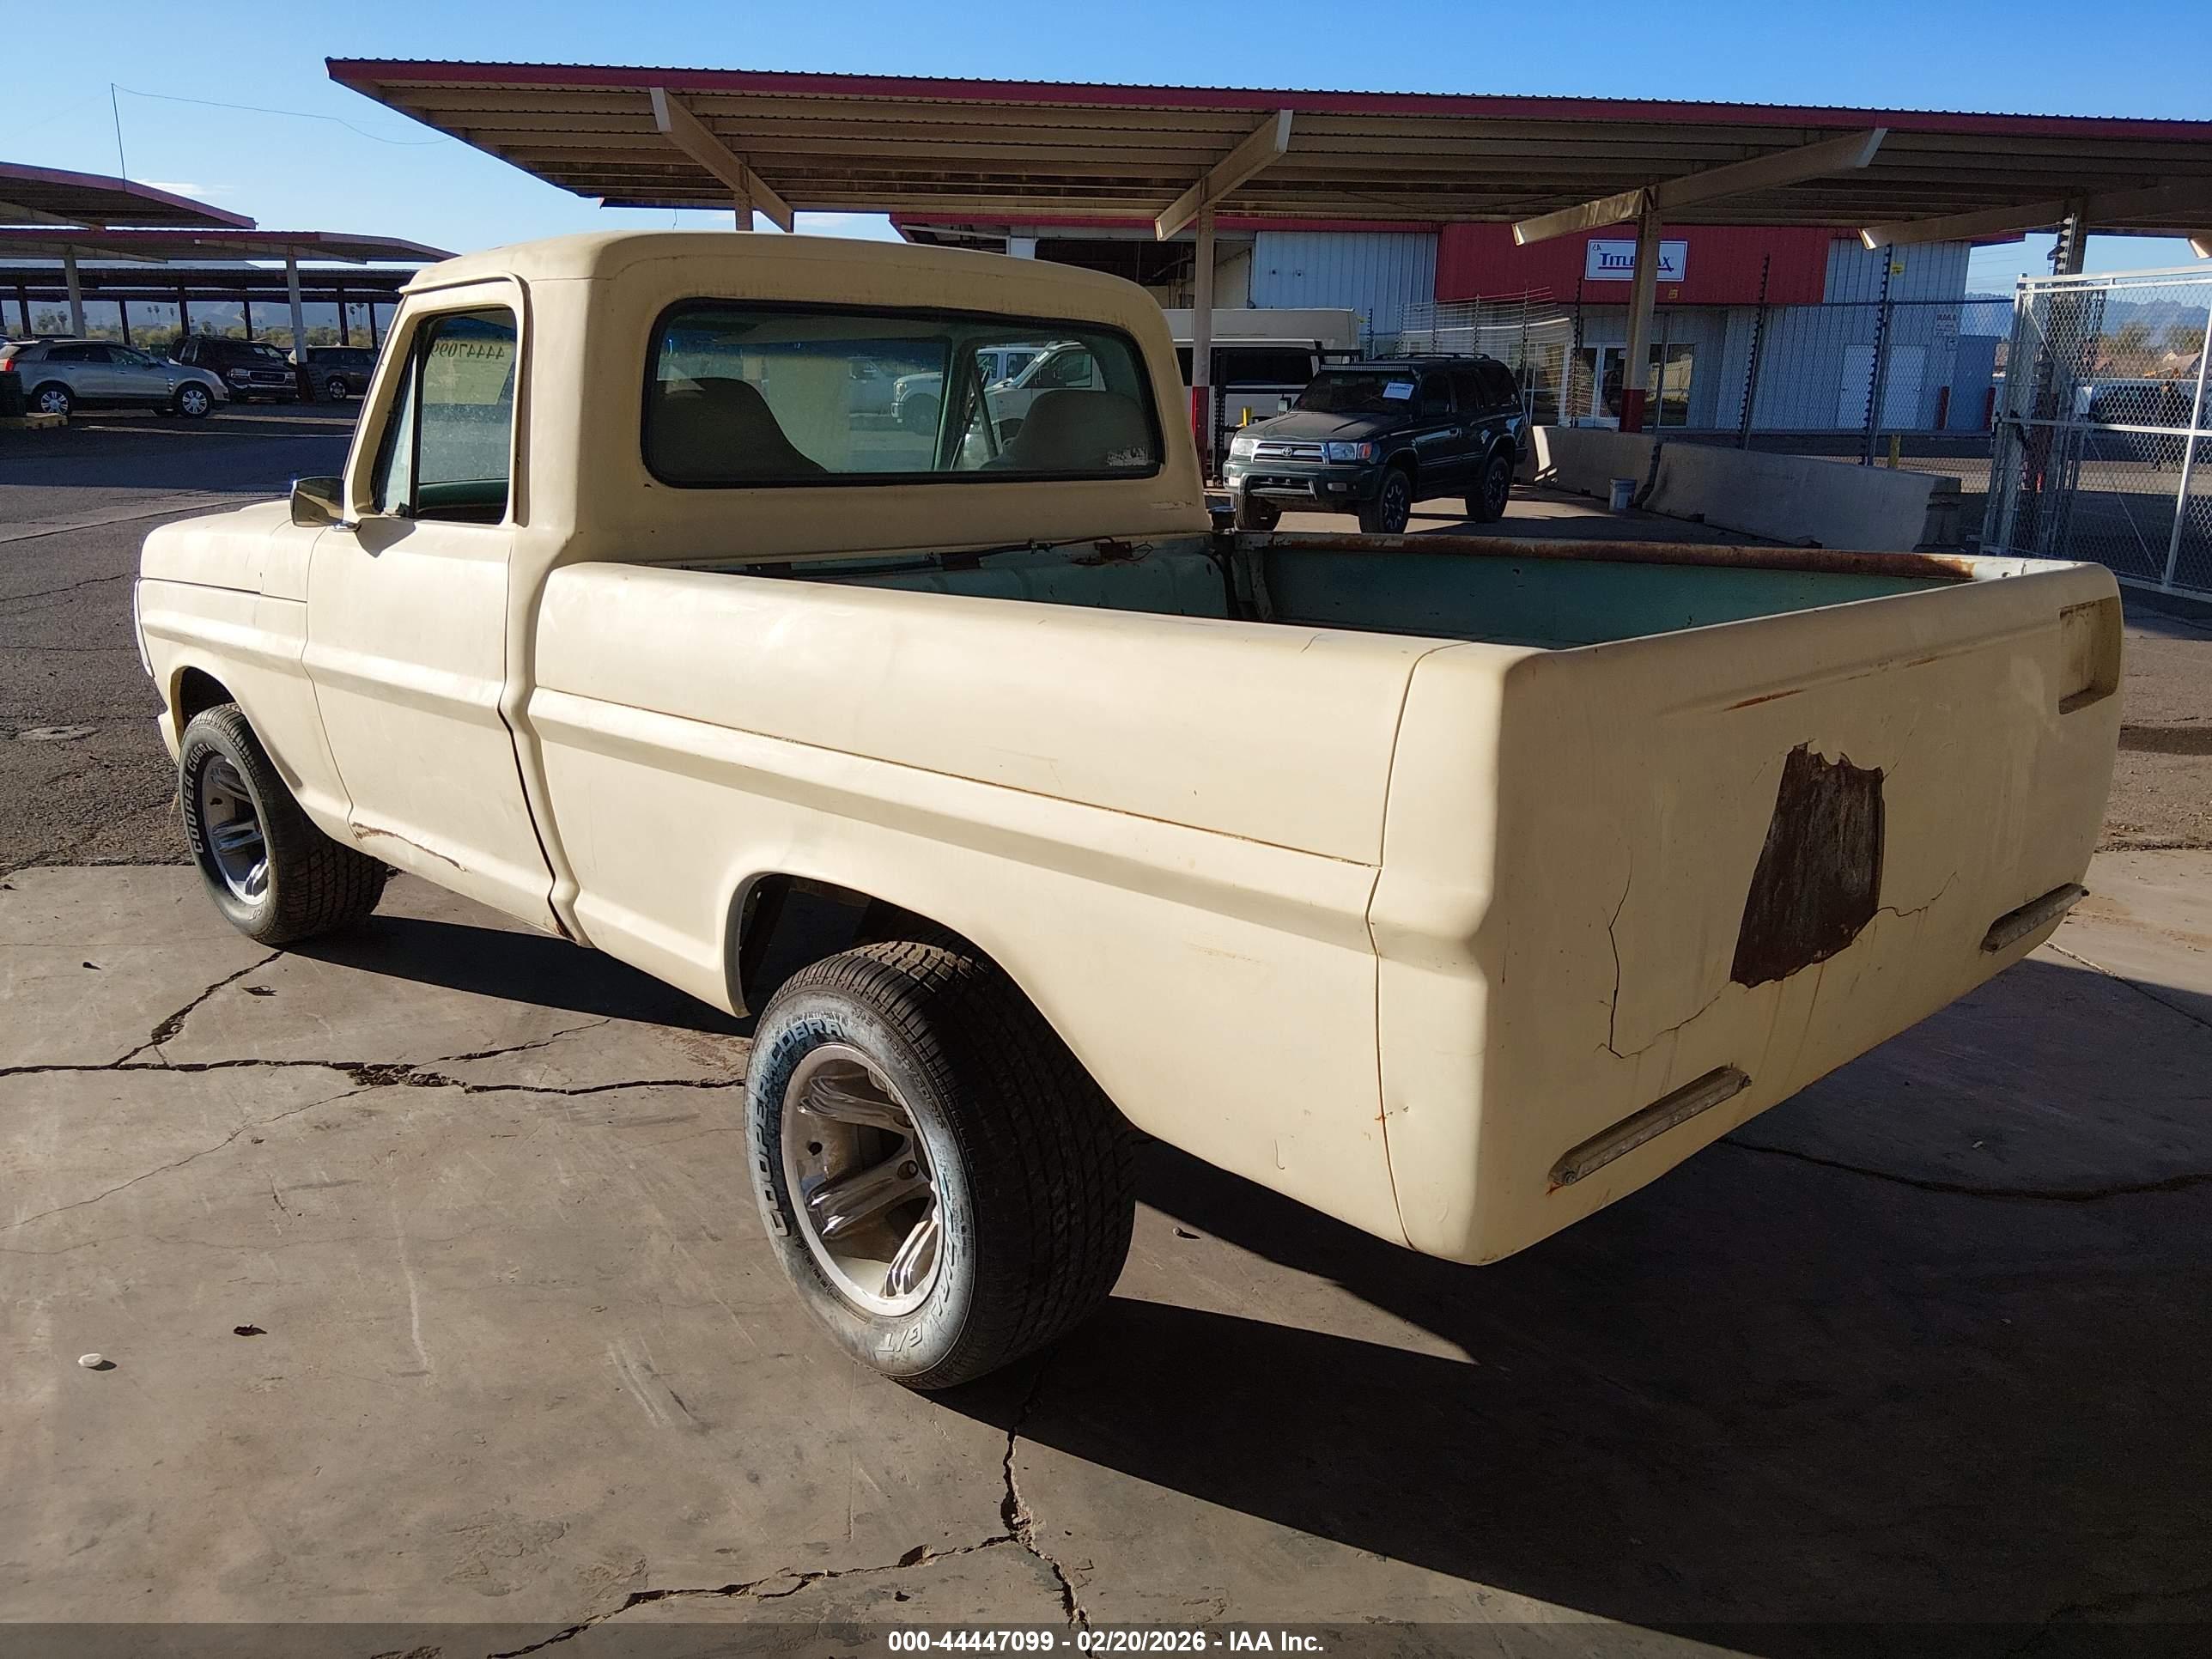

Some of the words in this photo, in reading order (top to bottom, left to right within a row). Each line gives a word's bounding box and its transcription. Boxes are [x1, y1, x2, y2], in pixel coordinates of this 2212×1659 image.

[186, 742, 215, 772] COBRA
[184, 773, 204, 854] COOPER
[769, 1018, 845, 1067] COBRA
[755, 1073, 788, 1237] COOPER
